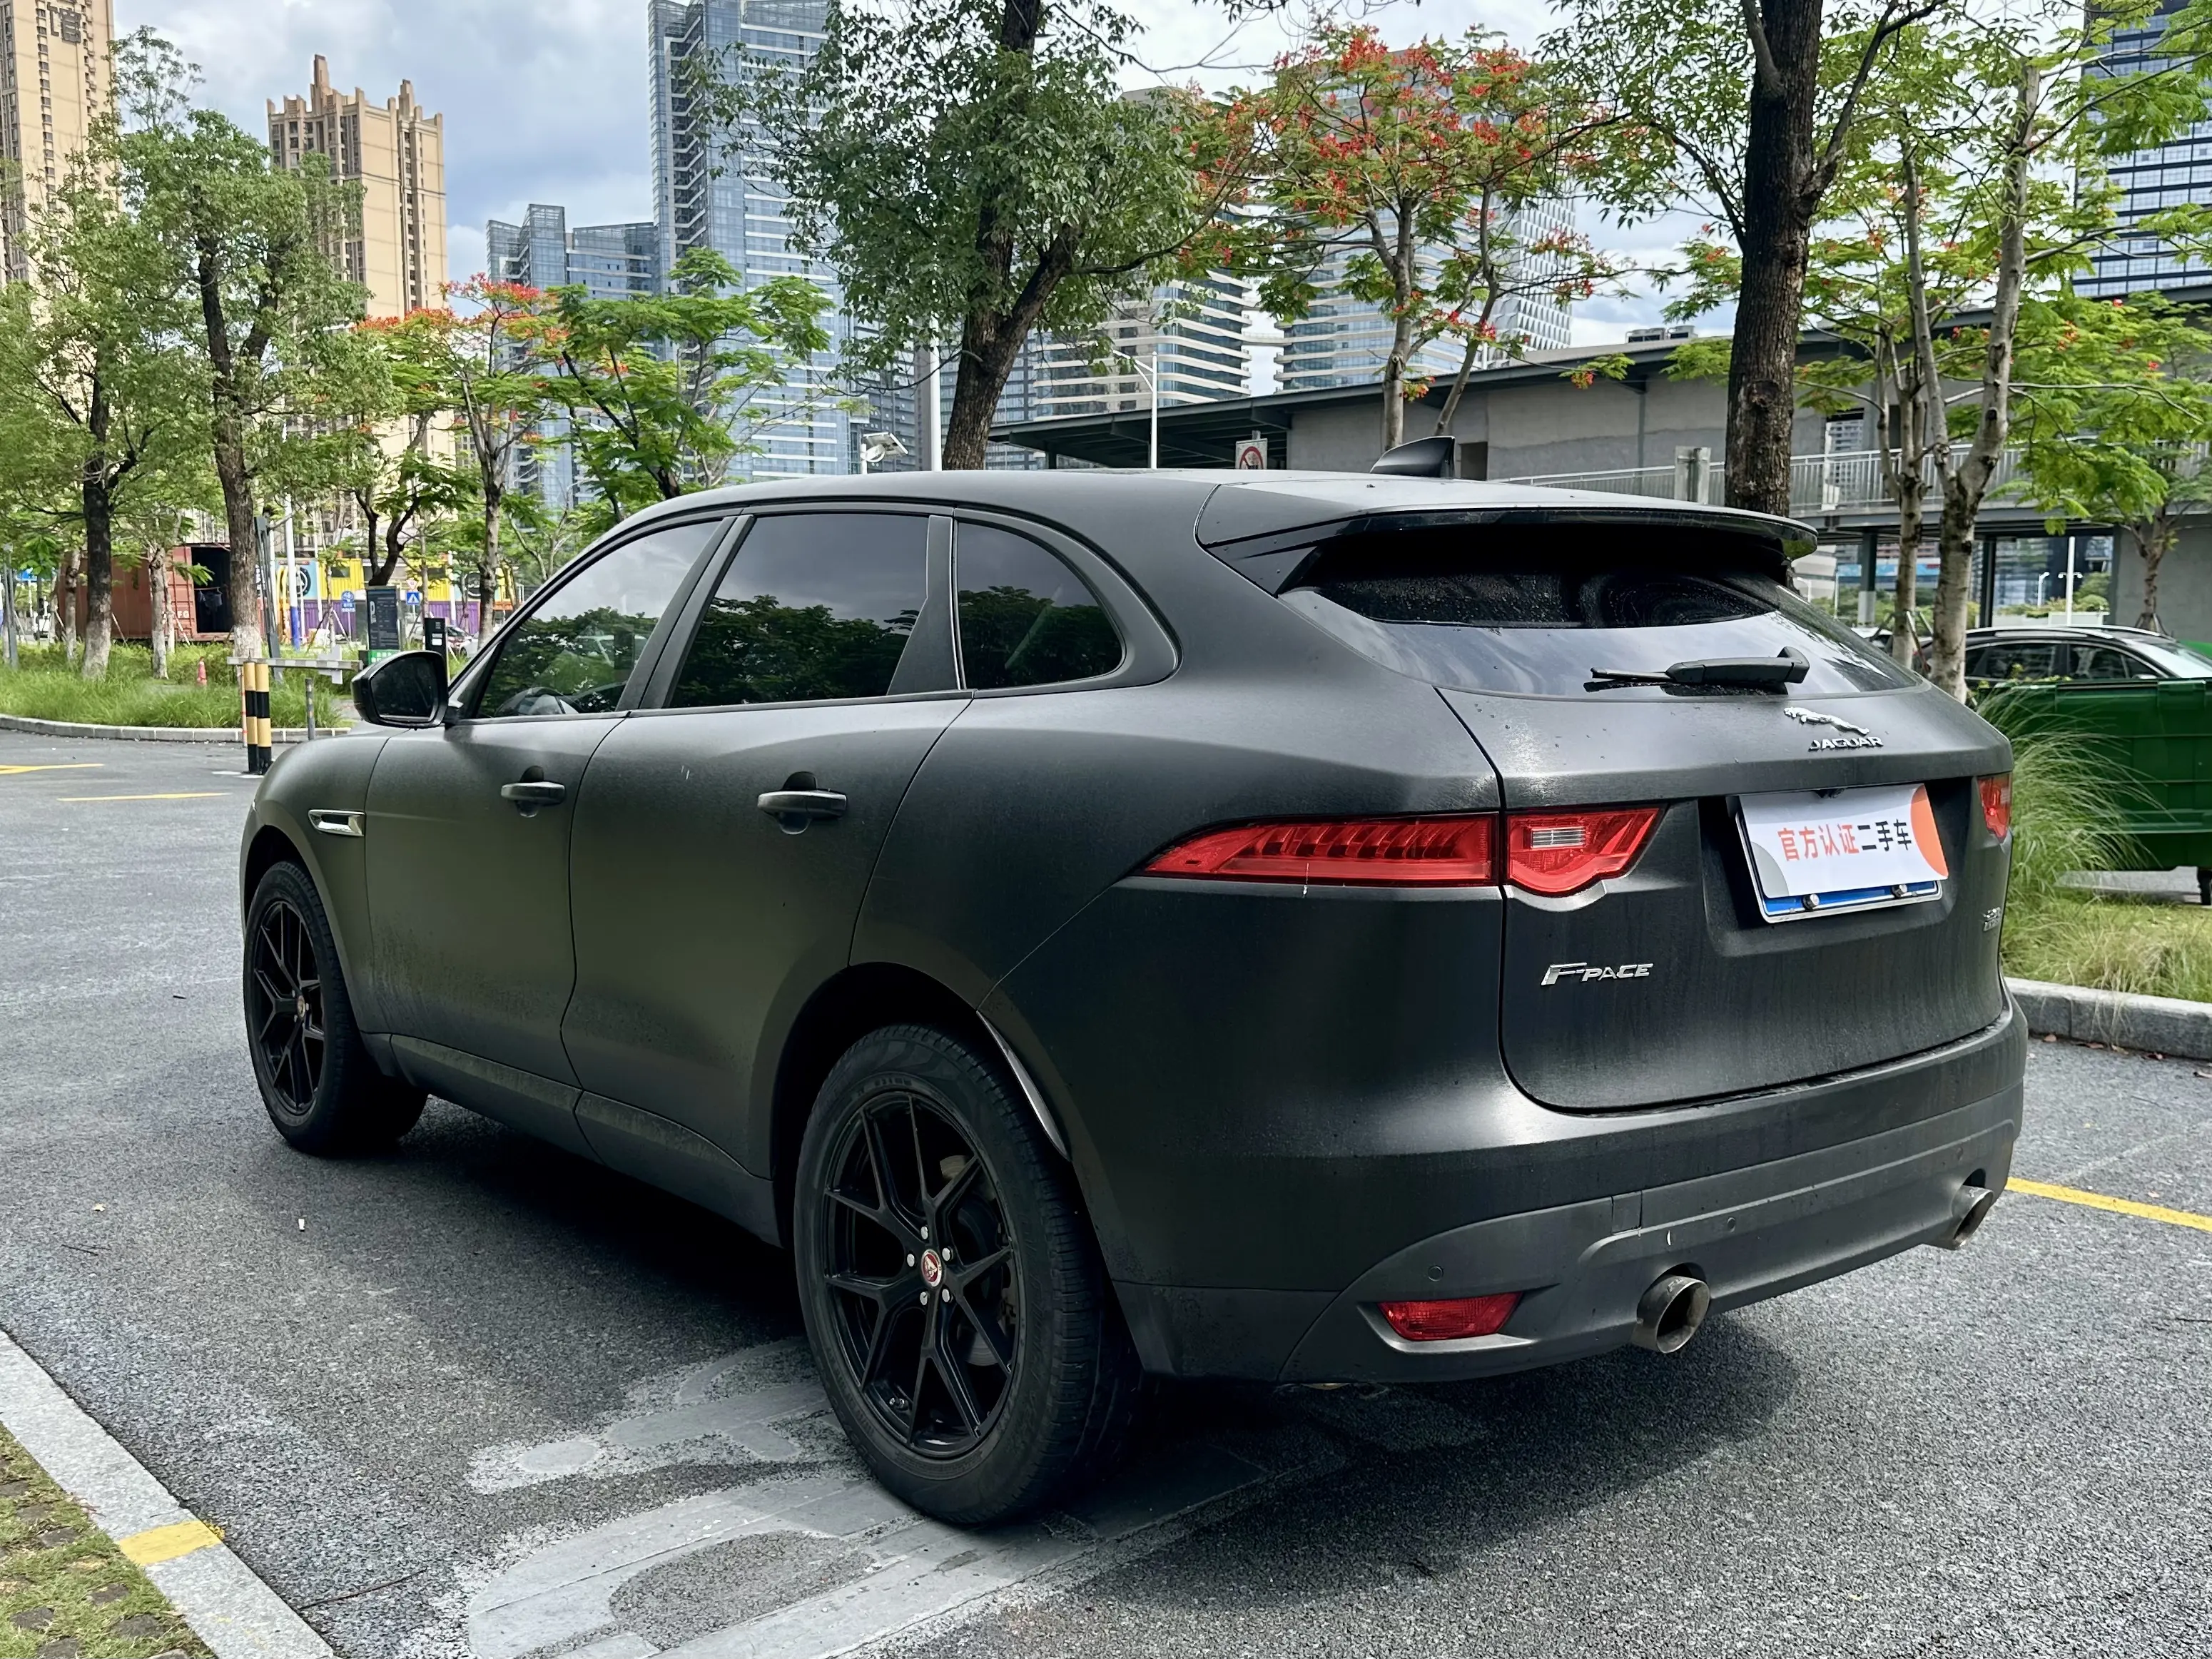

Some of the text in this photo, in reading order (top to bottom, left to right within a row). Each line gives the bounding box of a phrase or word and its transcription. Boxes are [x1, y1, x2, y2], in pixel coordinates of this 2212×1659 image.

[1809, 736, 1884, 751] JAGUAR
[1777, 818, 1912, 861] 官方认证二手车
